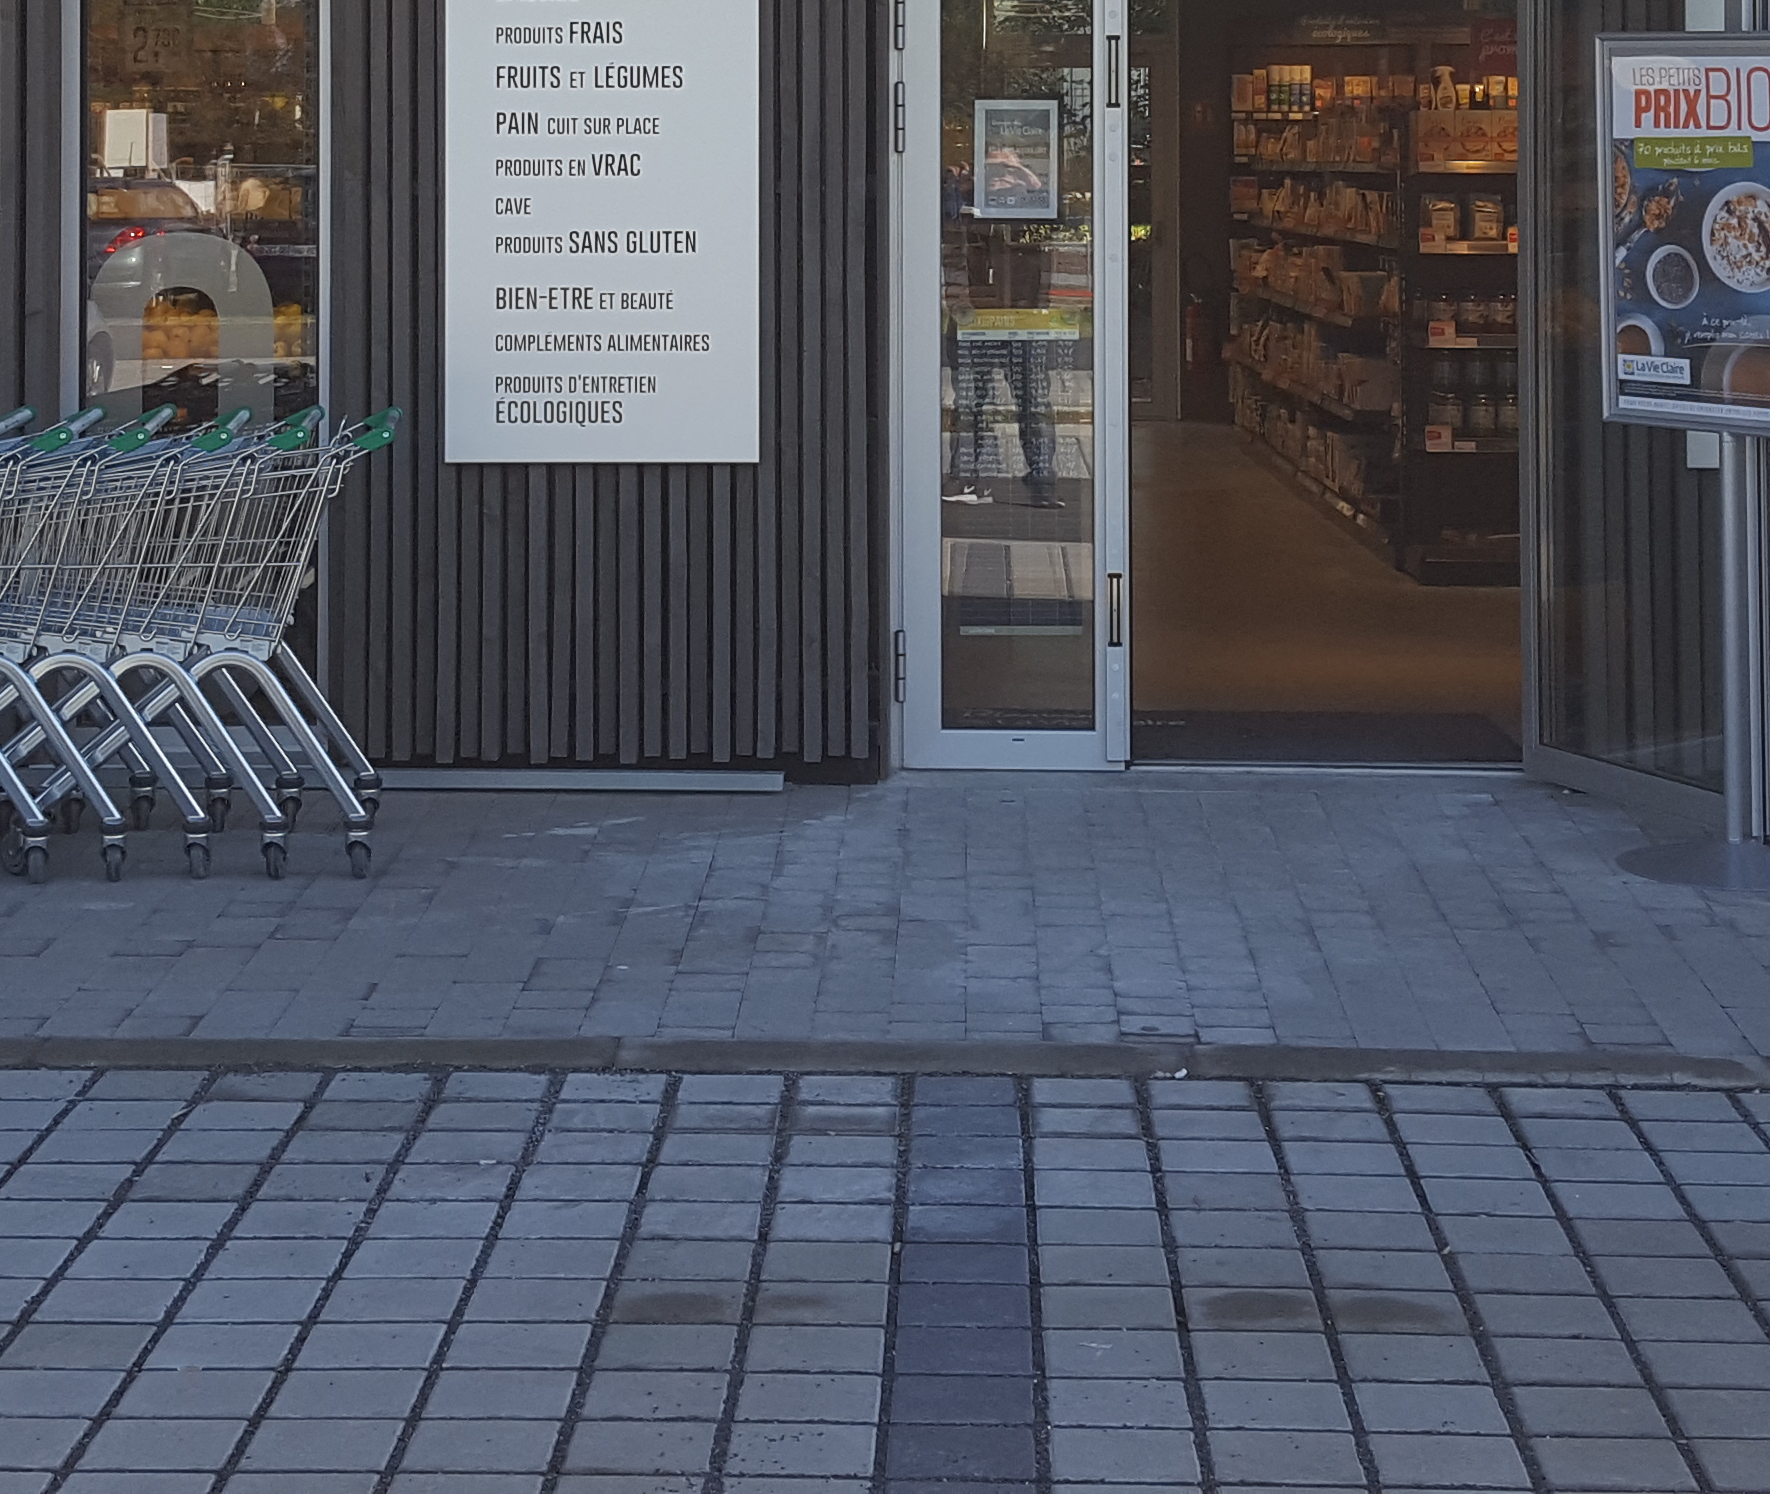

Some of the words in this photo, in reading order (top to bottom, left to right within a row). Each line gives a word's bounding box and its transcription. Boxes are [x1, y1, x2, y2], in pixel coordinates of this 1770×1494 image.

[495, 27, 563, 45] PRODUITS
[569, 21, 623, 44] FRAIS
[495, 66, 560, 89] FRUITS
[569, 71, 586, 89] ET
[593, 62, 683, 89] LÉGUMES
[1633, 68, 1655, 85] LES
[1660, 67, 1701, 86] PETITS
[1634, 89, 1702, 128] PRIX
[495, 111, 539, 135] PAIN
[547, 117, 579, 135] CUIT
[584, 117, 611, 135] SUR
[616, 117, 660, 135] PLACE
[495, 159, 563, 177] PRODUITS
[569, 159, 586, 176] EN
[591, 153, 641, 177] VRAC
[495, 197, 531, 215] CAVE
[495, 236, 563, 254] PRODUITS
[569, 230, 619, 254] SANS
[625, 230, 697, 254] GLUTEN
[495, 287, 593, 311] BIEN-ETRE
[599, 292, 616, 310] ET
[621, 289, 674, 310] BEAUTÉ
[495, 332, 602, 352] COMPLÉMENTS
[607, 333, 710, 352] ALIMENTAIRES
[1636, 361, 1646, 371] La
[1646, 362, 1660, 372] Vie
[1661, 362, 1684, 374] Claire
[495, 376, 563, 394] PRODUITS
[569, 375, 656, 394] D'ENTRETIEN
[495, 397, 623, 426] ÉCOLOGIQUES
